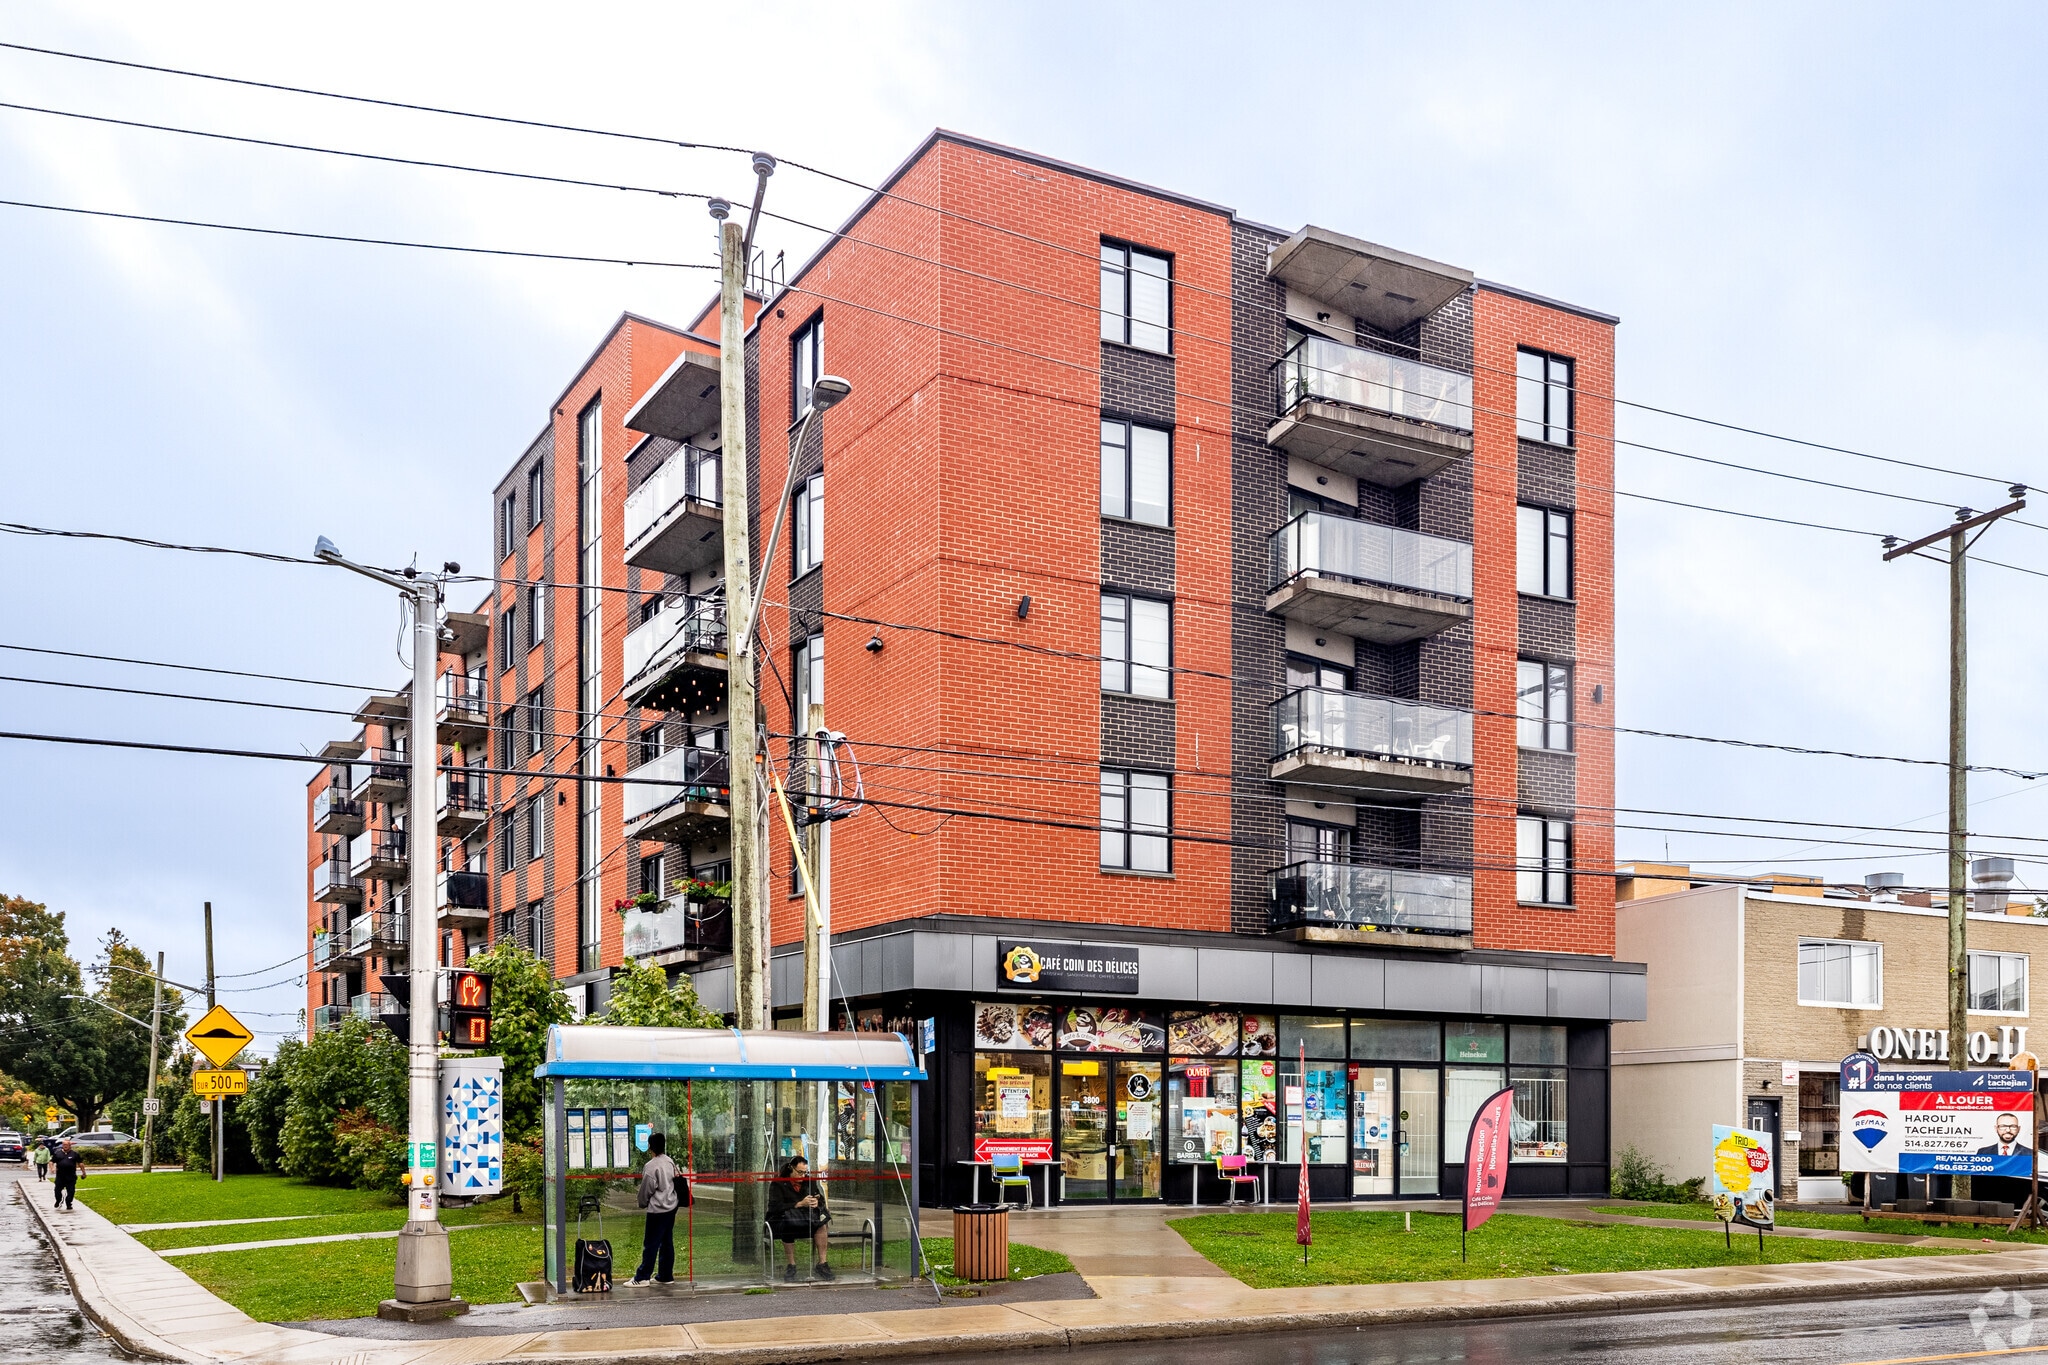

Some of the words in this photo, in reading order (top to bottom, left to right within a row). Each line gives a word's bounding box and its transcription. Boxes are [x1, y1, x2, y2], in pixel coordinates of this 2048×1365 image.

[1041, 955, 1060, 970] CAFÉ
[1064, 958, 1084, 972] COIN
[1088, 960, 1102, 972] DES
[1106, 958, 1138, 974] DÉLICES
[470, 1019, 485, 1042] 0
[1869, 1026, 1990, 1063] ONEIO
[1844, 1056, 1855, 1064] nous
[1856, 1054, 1875, 1064] sommes
[1186, 1067, 1210, 1077] OUVERT
[211, 1076, 231, 1089] 500
[1083, 1096, 1099, 1104] 3800
[1936, 1094, 1945, 1104] À
[1950, 1096, 1993, 1104] LOUER
[145, 1102, 157, 1111] 30
[1905, 1126, 1972, 1134] TACHEJIAN
[1735, 1136, 1748, 1146] TRIO
[1905, 1140, 1968, 1148] 514.827.7667
[1490, 1134, 1498, 1170] Nouvelles
[1933, 1164, 1994, 1172] 450.682.2000
